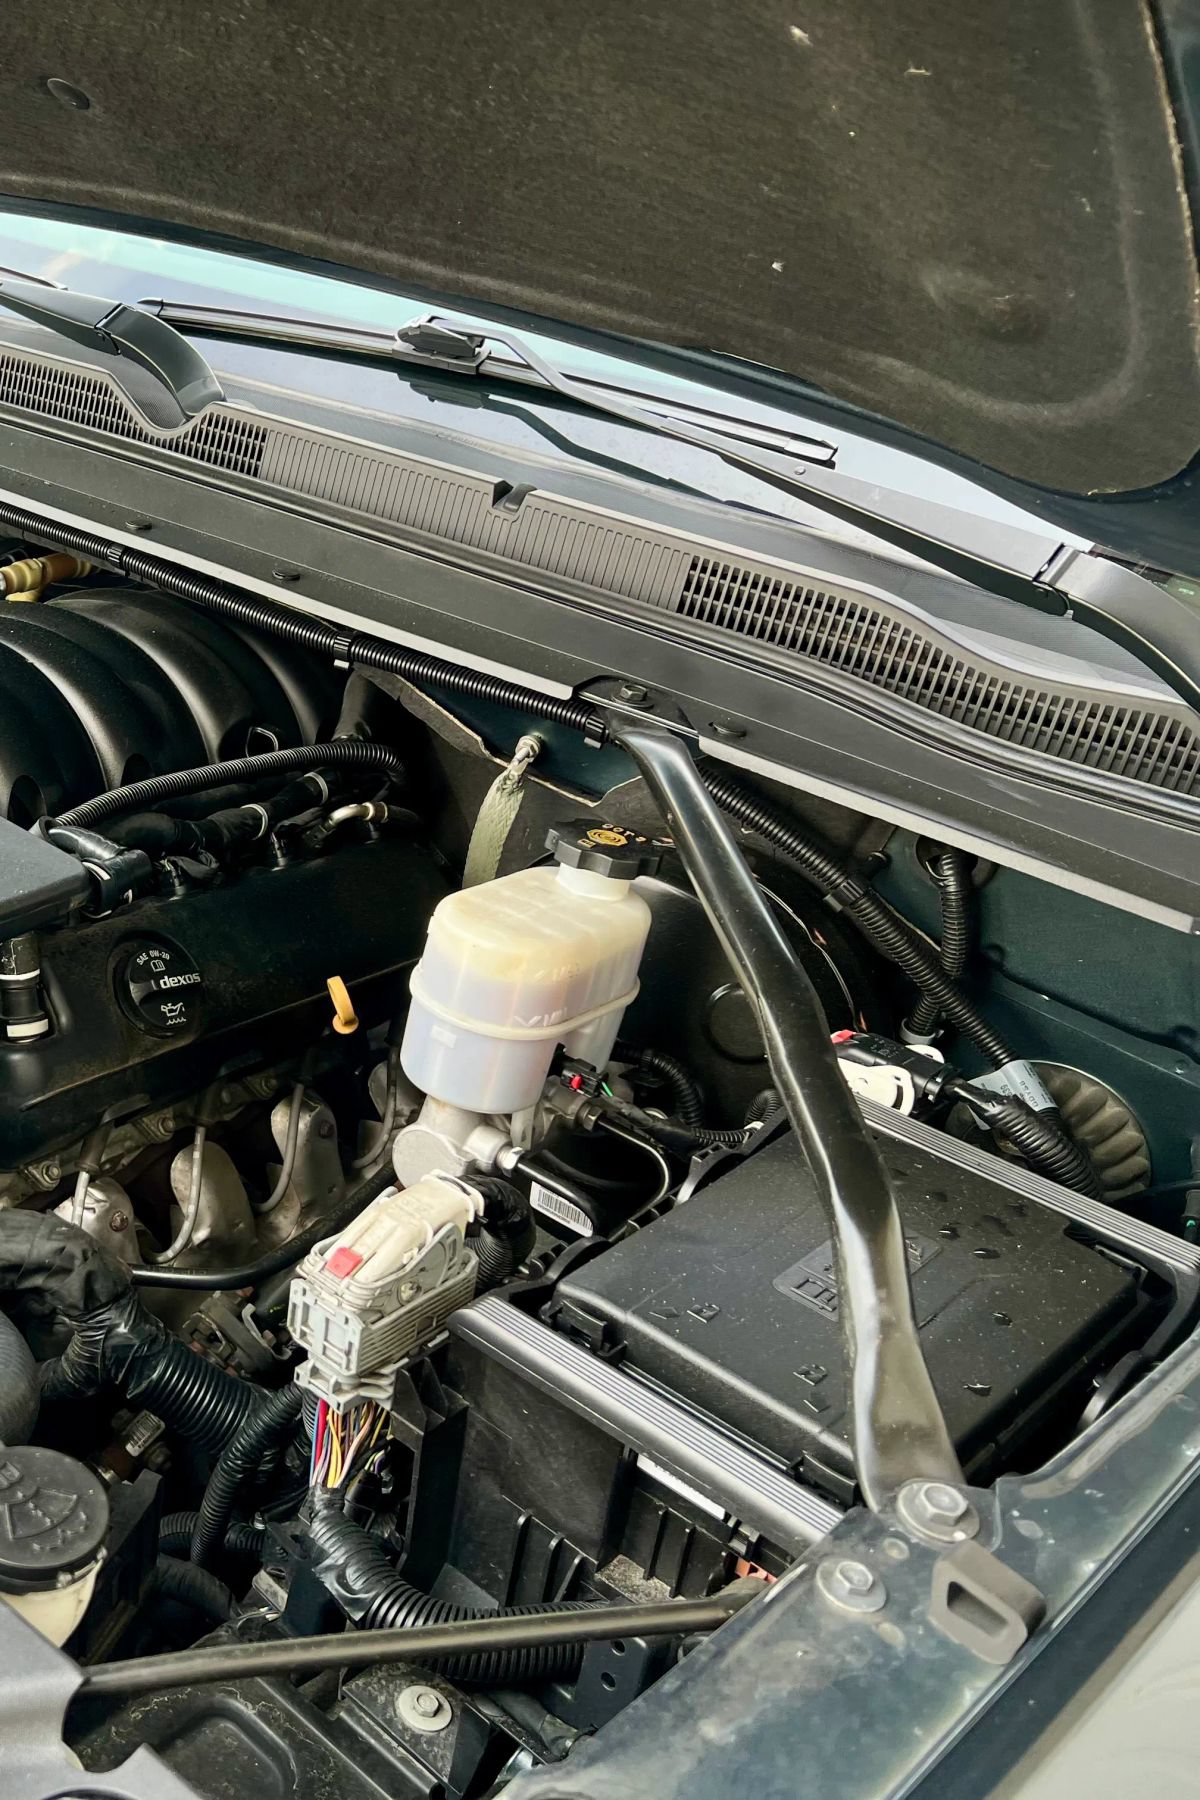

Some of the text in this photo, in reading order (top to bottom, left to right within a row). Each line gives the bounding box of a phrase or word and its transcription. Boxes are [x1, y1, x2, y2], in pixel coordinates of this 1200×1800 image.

[136, 950, 170, 966] SAE 0W-20
[160, 973, 200, 989] dexos
